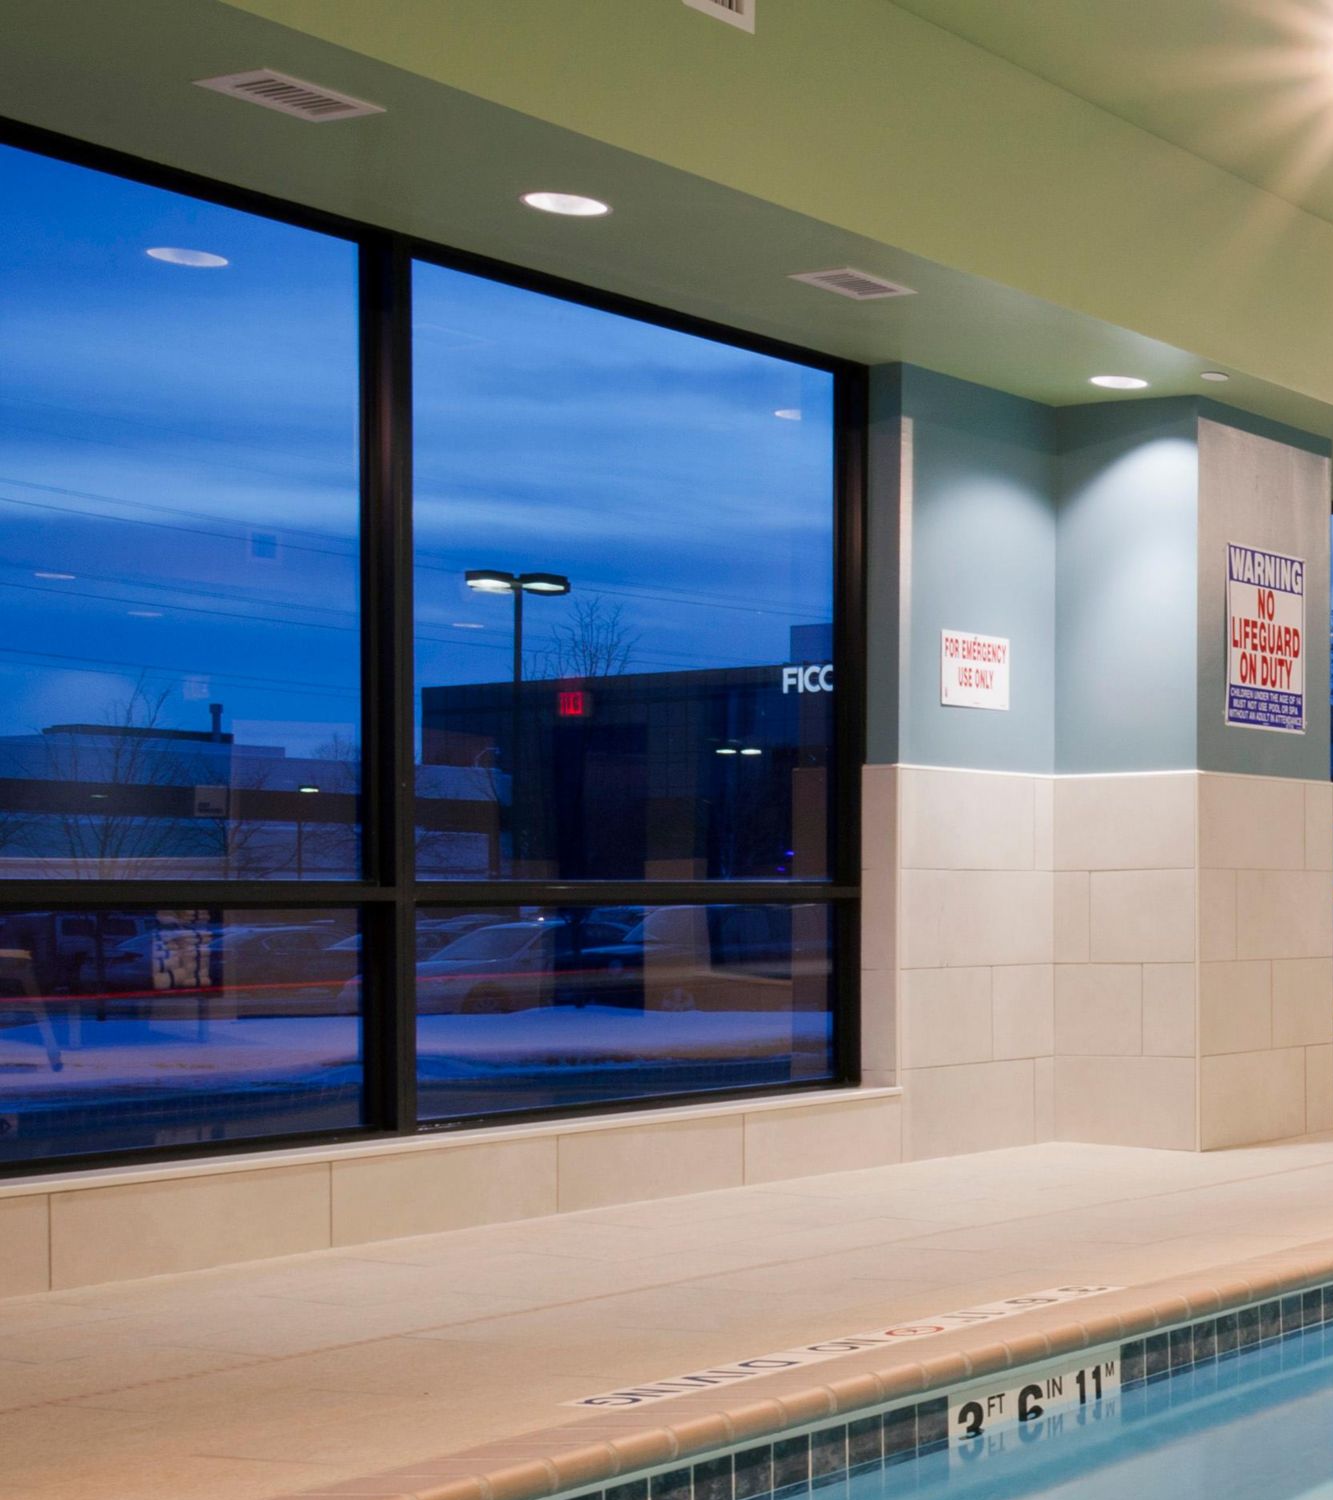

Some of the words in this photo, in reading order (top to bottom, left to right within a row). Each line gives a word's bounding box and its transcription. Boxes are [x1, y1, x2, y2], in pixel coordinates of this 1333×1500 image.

[1230, 547, 1302, 594] WARNING
[1258, 588, 1275, 621] NO
[945, 637, 959, 658] FOR
[962, 640, 1006, 664] EMERGENCY
[1232, 616, 1300, 658] LIFEGUARD
[959, 667, 972, 687] USE
[975, 669, 994, 689] ONLY
[1240, 651, 1257, 685] ON
[1261, 655, 1292, 689] DUTY
[1230, 687, 1254, 698] CHILDREN
[1254, 690, 1269, 700] UNDER
[1270, 692, 1279, 702] THE
[1233, 698, 1246, 708] MUST
[1247, 700, 1257, 709] NOT
[1258, 702, 1267, 711] USE
[1268, 703, 1281, 713] POOL
[1289, 705, 1299, 715] SPA
[807, 1338, 890, 1352] NO
[583, 1359, 801, 1405] DIVING
[958, 1401, 984, 1440] 3
[987, 1393, 1005, 1417] FT
[1018, 1384, 1044, 1422] 6
[1046, 1376, 1063, 1400] IN
[1105, 1361, 1115, 1377] M
